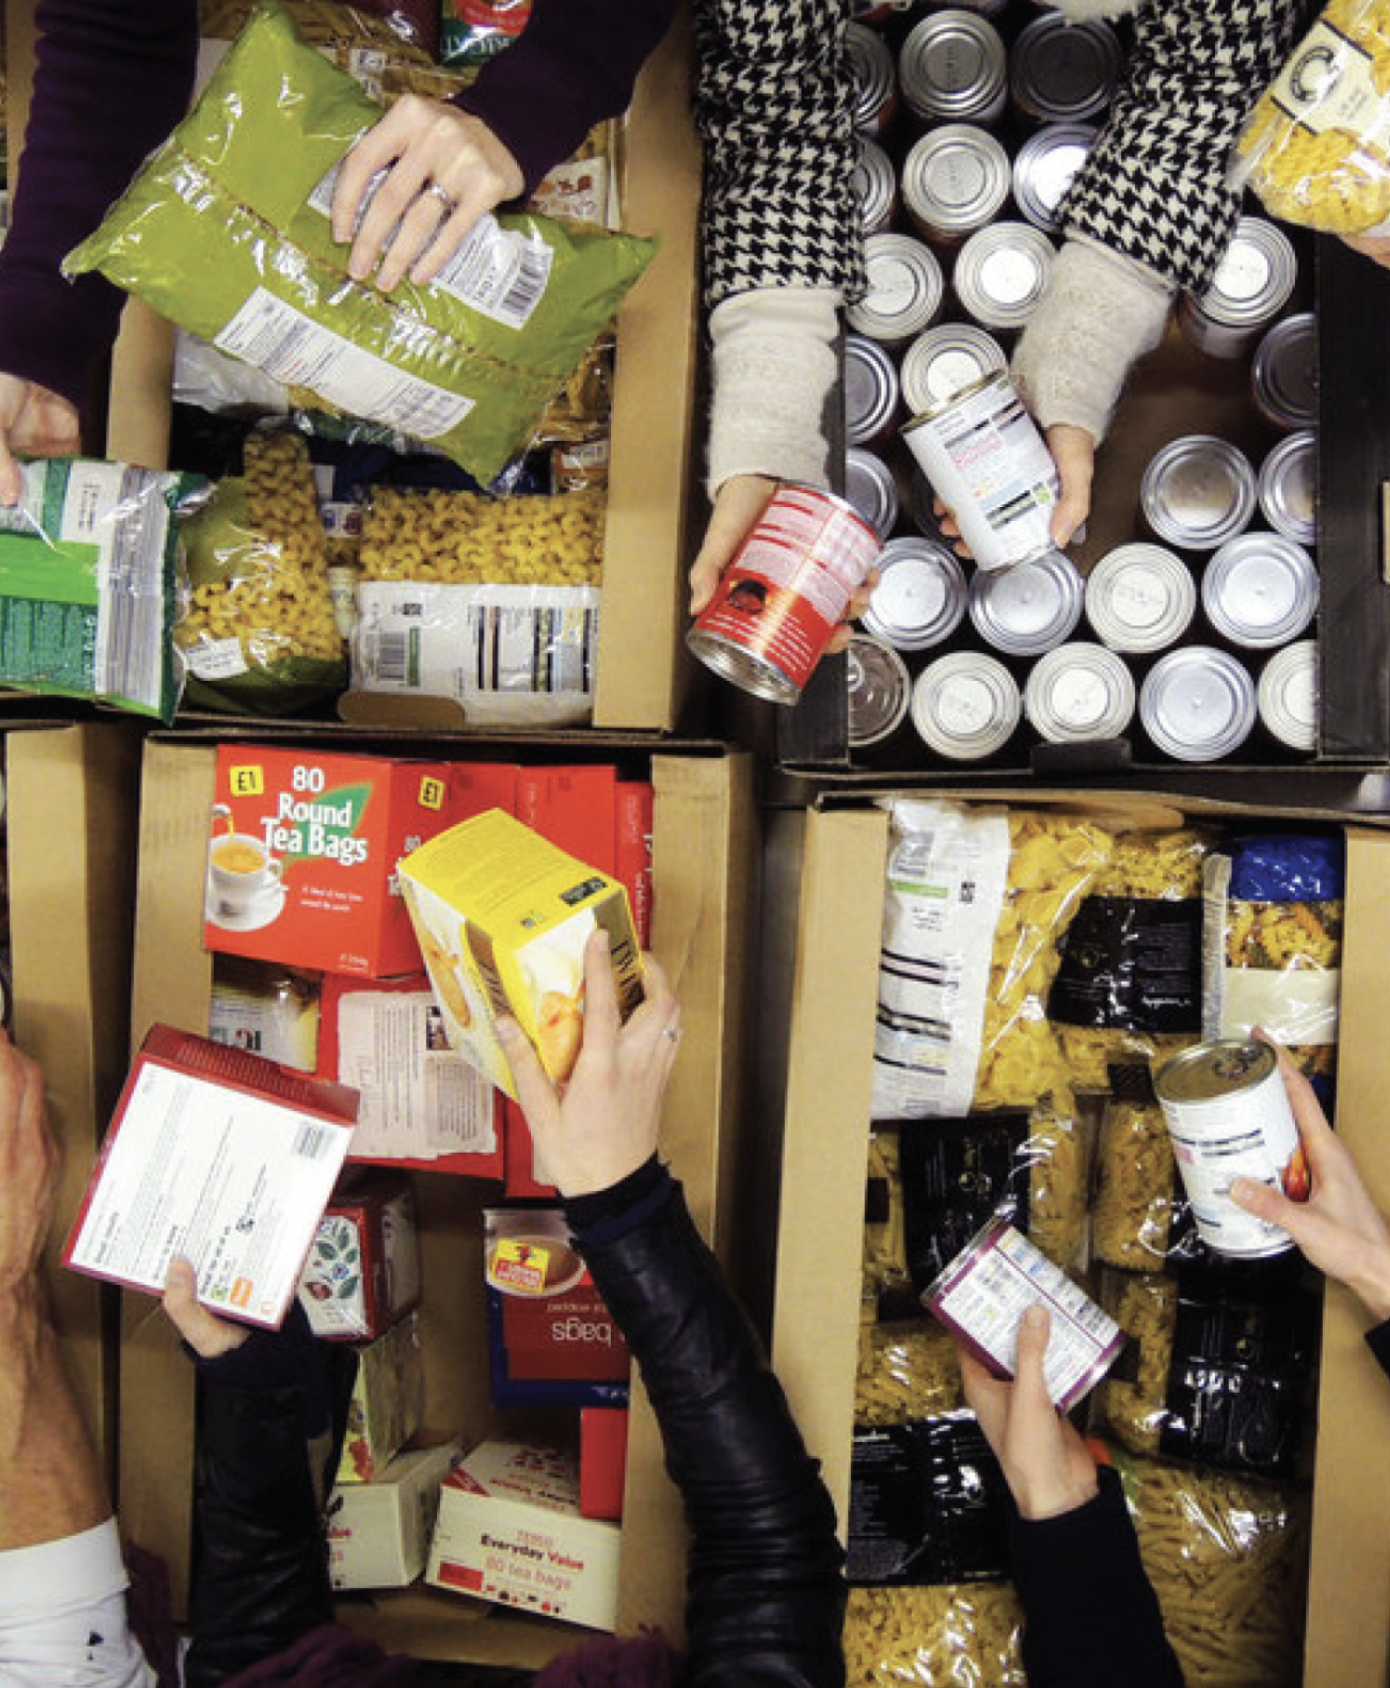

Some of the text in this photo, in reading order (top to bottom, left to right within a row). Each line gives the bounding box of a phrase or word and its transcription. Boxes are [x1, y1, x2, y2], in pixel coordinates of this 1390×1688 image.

[291, 766, 325, 793] 80
[278, 792, 353, 828] Round
[260, 817, 369, 867] Tea Bags
[552, 1317, 612, 1348] bags
